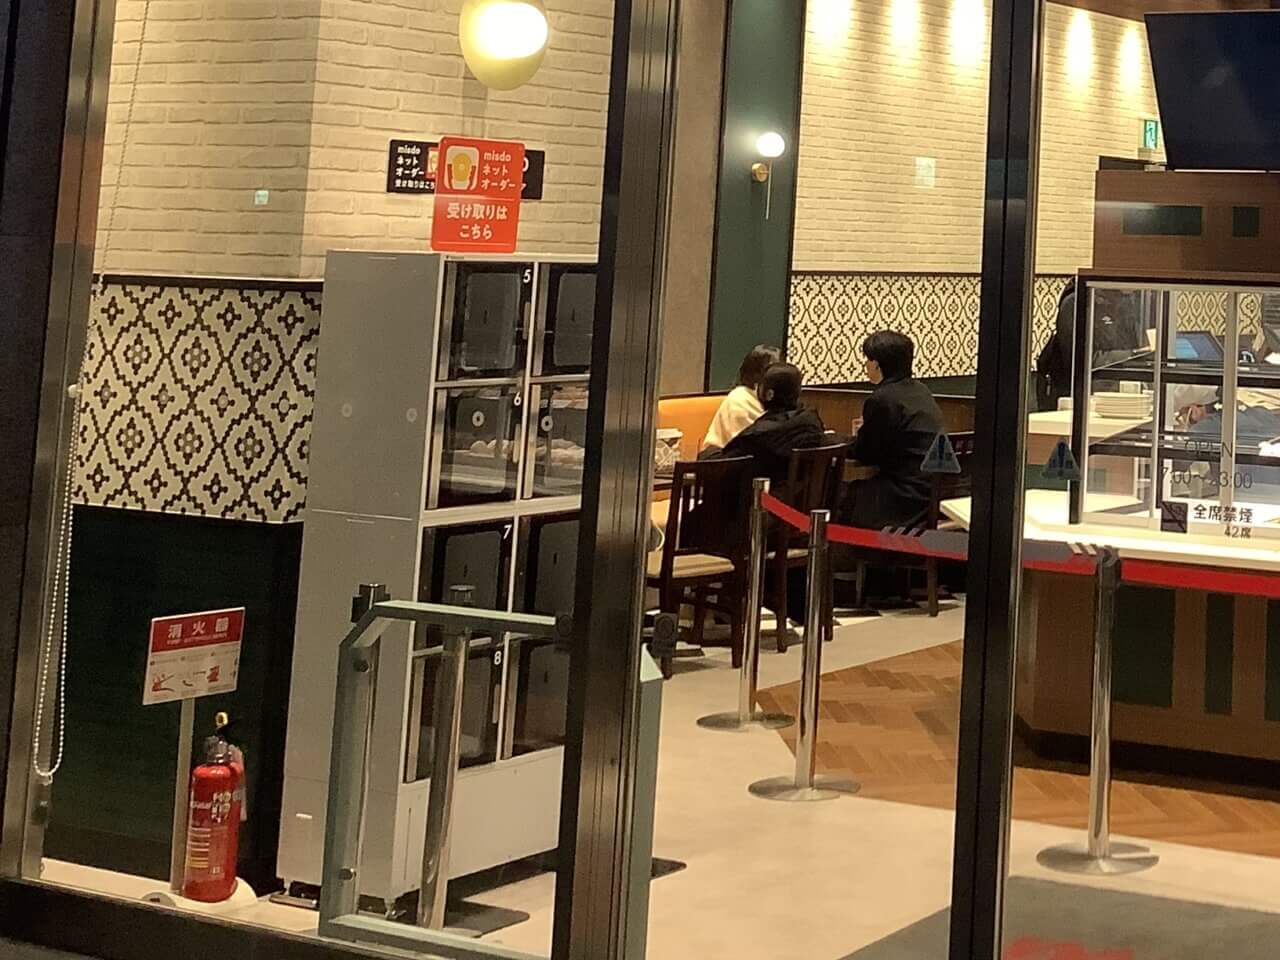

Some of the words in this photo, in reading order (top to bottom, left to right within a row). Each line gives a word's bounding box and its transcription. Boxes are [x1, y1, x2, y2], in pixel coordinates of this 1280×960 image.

[483, 151, 512, 161] misdo
[482, 165, 509, 176] ネット
[481, 179, 516, 191] オーダー
[447, 202, 508, 220] 受け取りは
[459, 224, 493, 240] こちら
[522, 269, 532, 284] 5
[513, 392, 522, 406] 6
[1193, 503, 1254, 524] 全席禁煙
[503, 525, 513, 540] 7
[493, 651, 502, 666] 8
